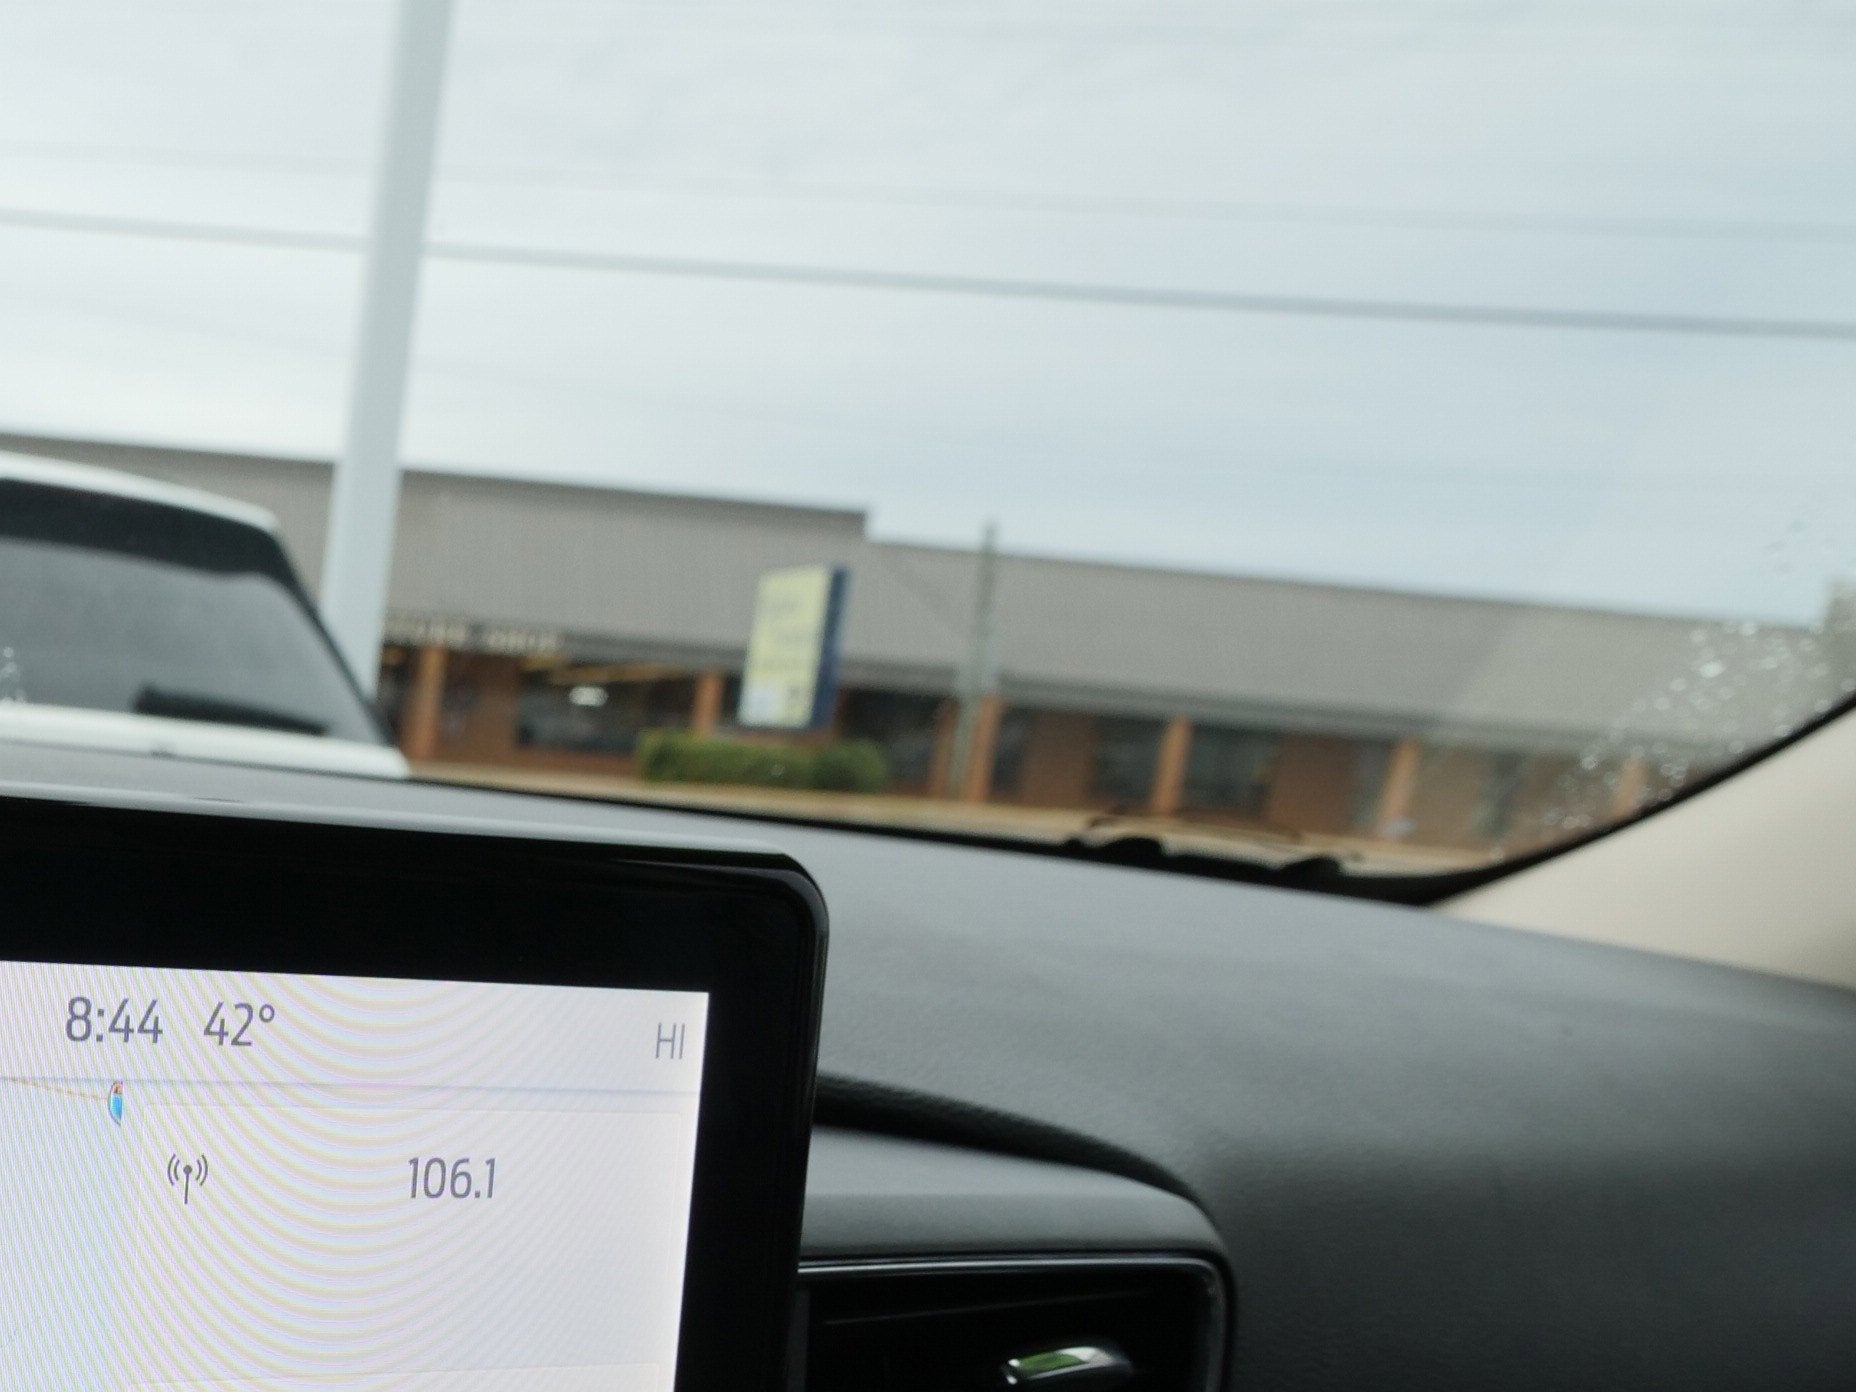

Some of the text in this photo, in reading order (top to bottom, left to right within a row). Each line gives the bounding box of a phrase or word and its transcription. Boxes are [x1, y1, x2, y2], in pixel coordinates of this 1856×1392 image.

[66, 996, 276, 1047] 8:44 42°
[655, 1023, 685, 1060] HI
[408, 1157, 496, 1200] 106.1
